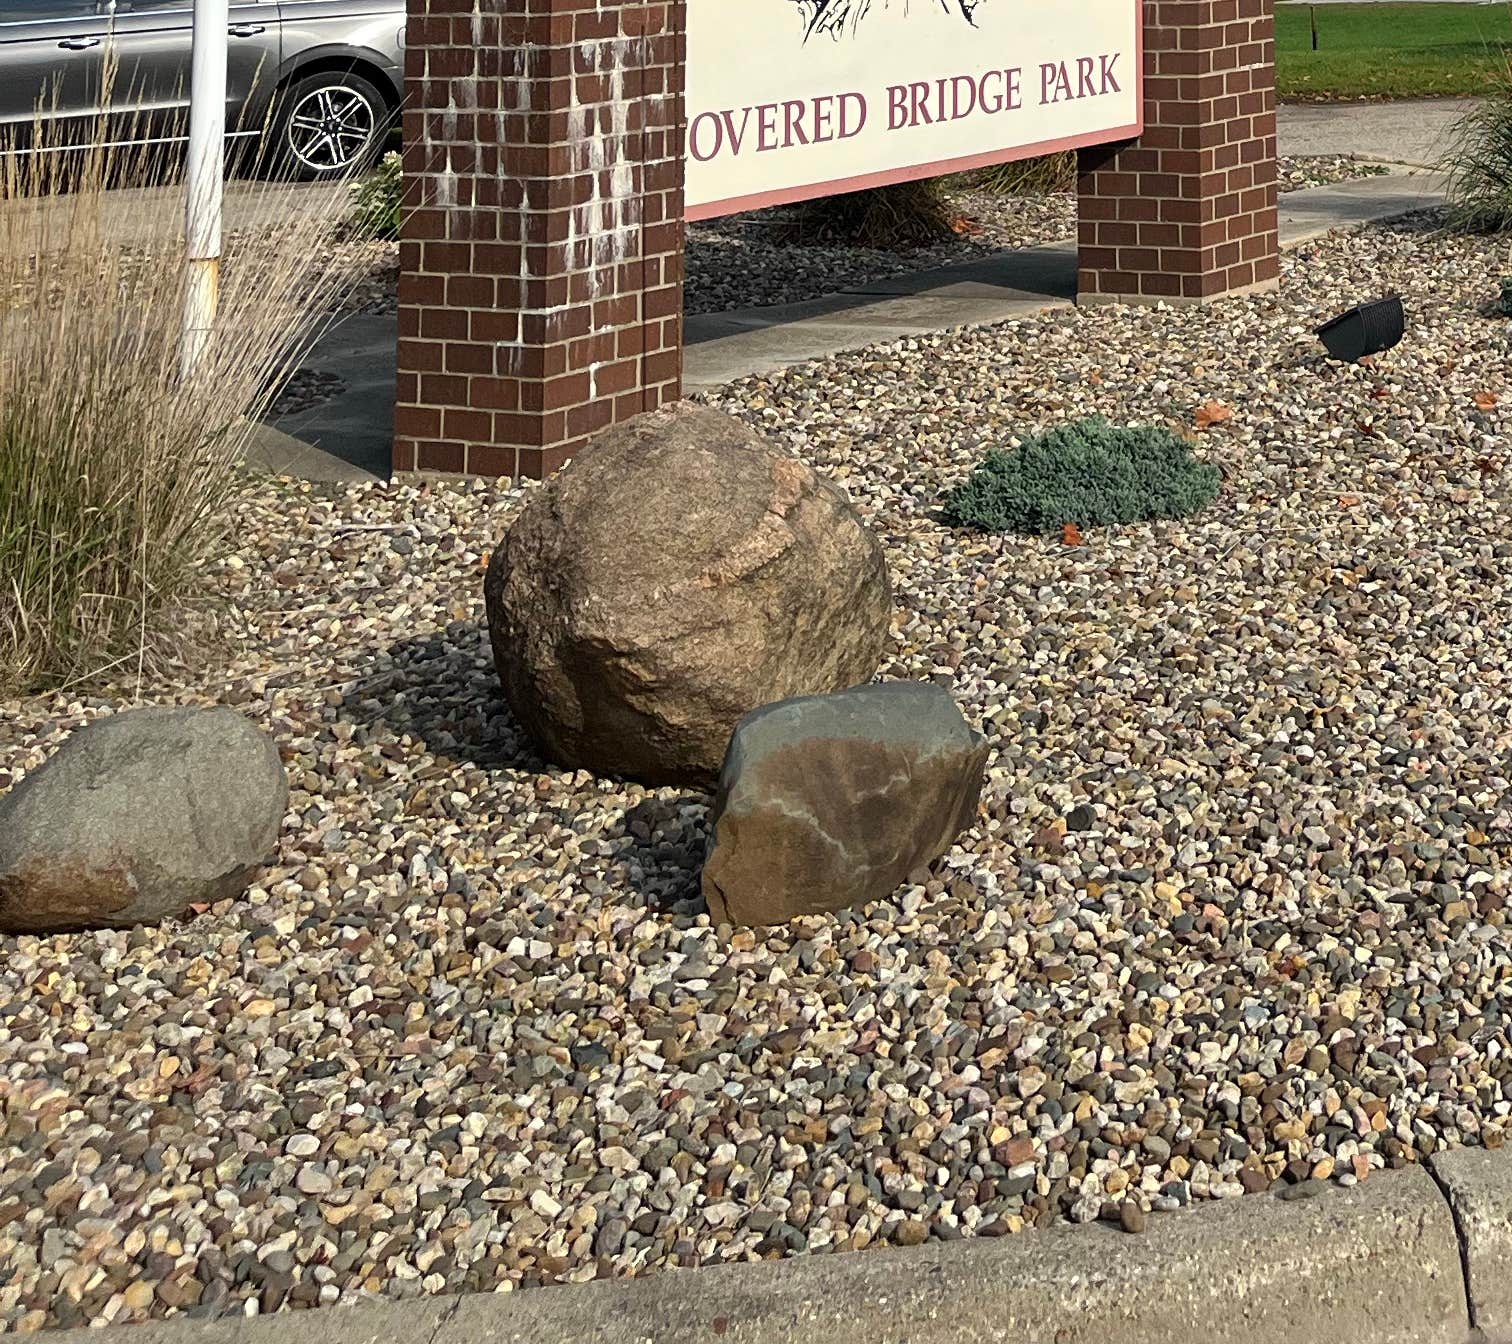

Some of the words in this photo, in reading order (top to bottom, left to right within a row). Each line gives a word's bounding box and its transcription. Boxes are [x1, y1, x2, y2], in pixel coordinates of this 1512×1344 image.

[686, 92, 867, 162] OVERED
[886, 67, 1022, 131] BRIDGE
[1038, 53, 1121, 106] PARK
